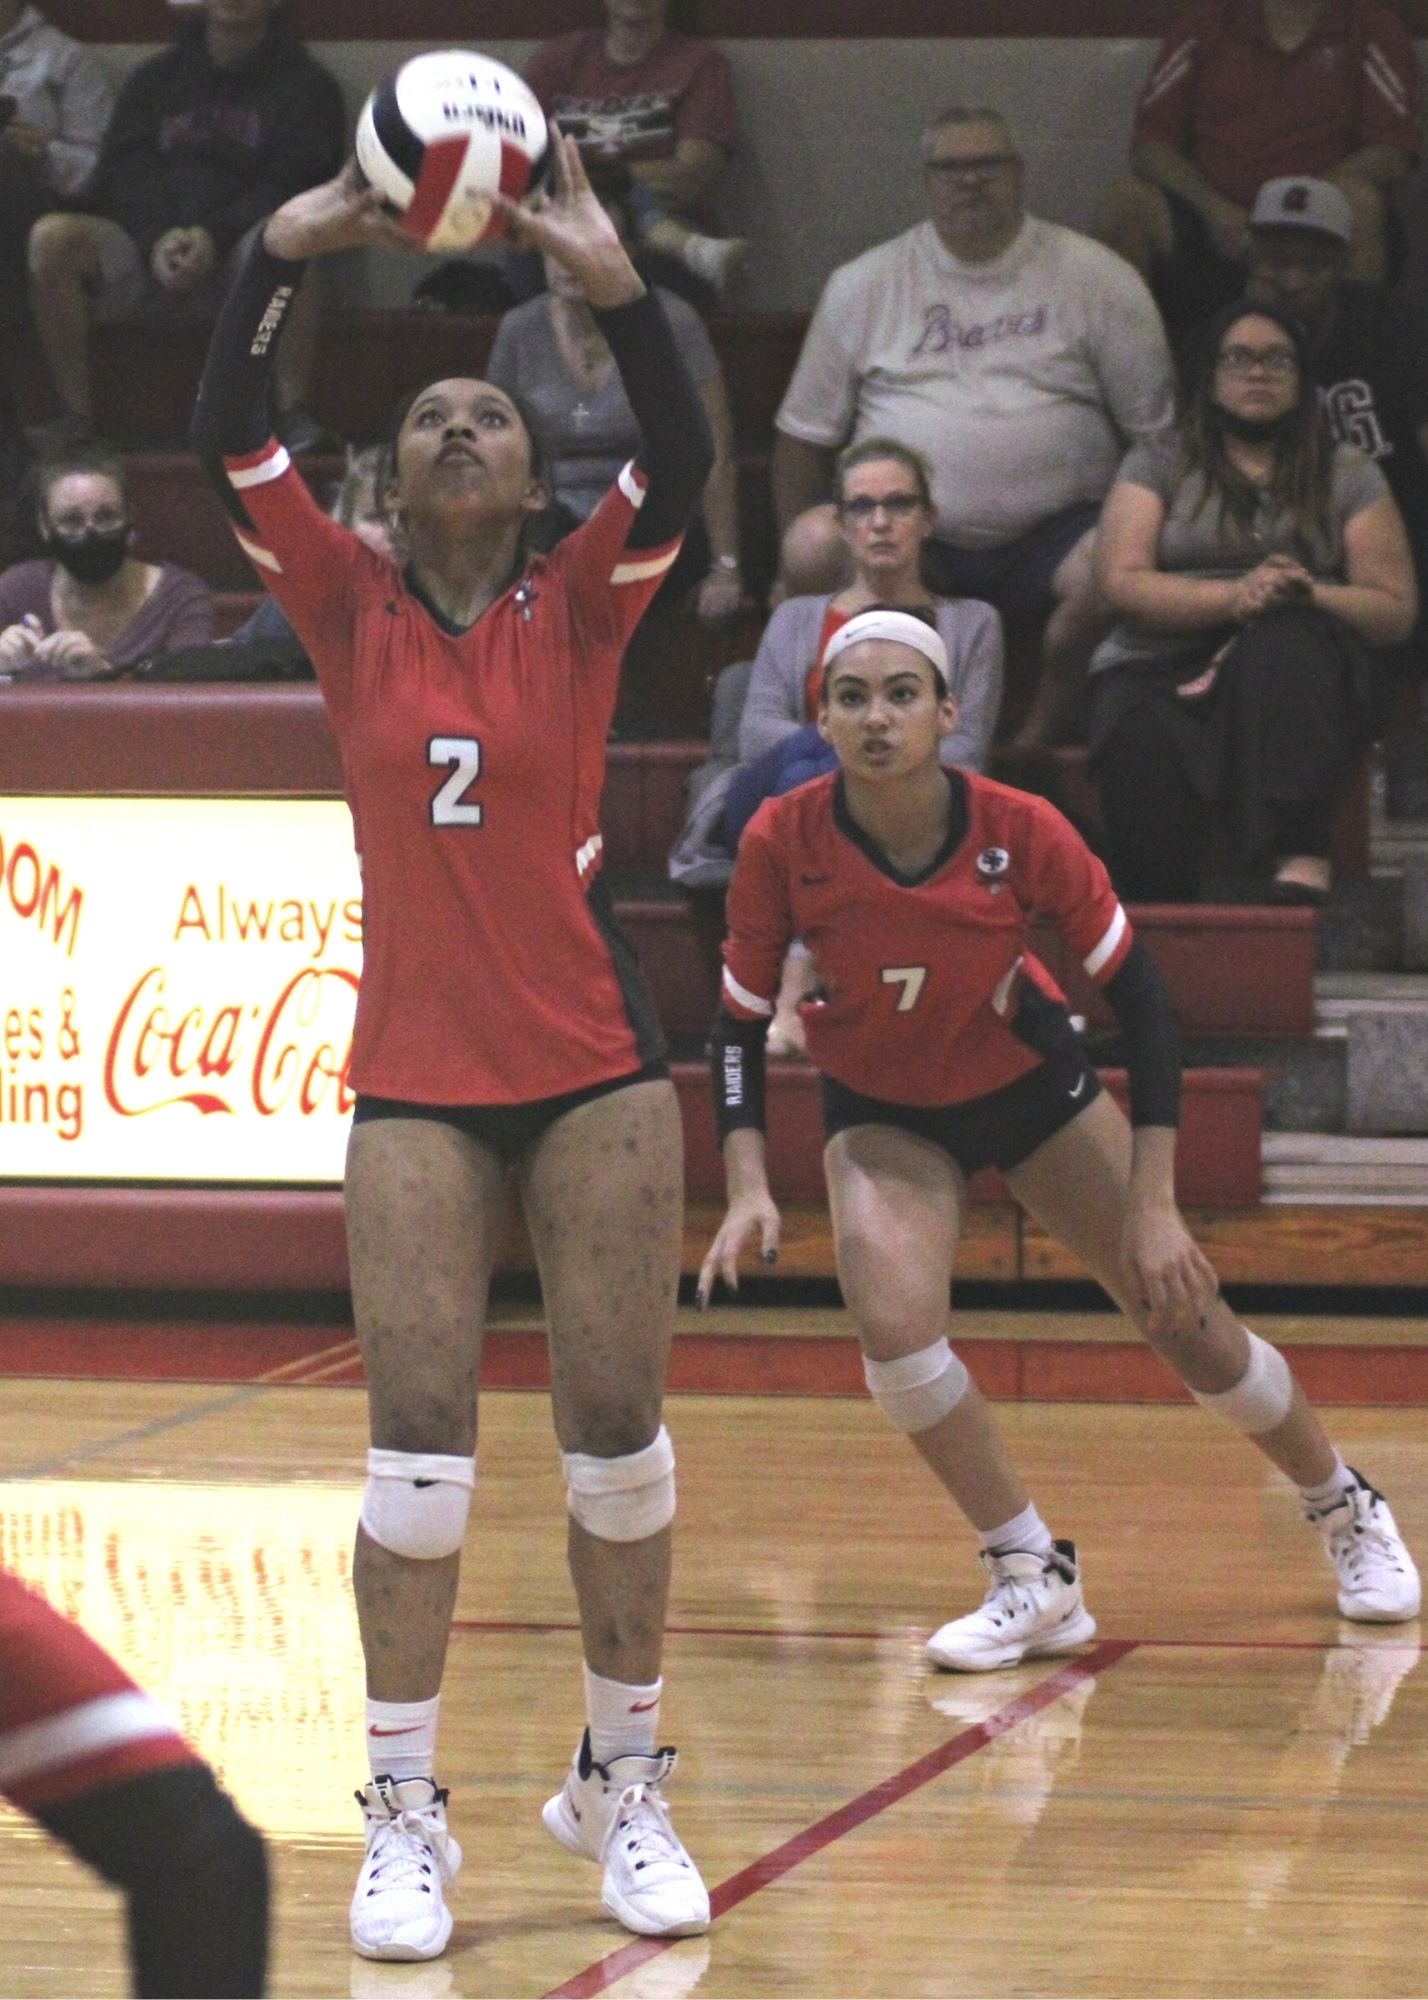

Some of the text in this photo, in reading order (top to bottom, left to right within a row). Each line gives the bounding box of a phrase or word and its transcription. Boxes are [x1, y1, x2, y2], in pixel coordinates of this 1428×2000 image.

[427, 736, 484, 826] 2
[0, 832, 82, 957] OM
[174, 884, 363, 958] Always
[59, 987, 81, 1060] &
[881, 966, 927, 1012] 7
[103, 966, 361, 1117] Coca-Col
[724, 1046, 743, 1105] RAIDERS
